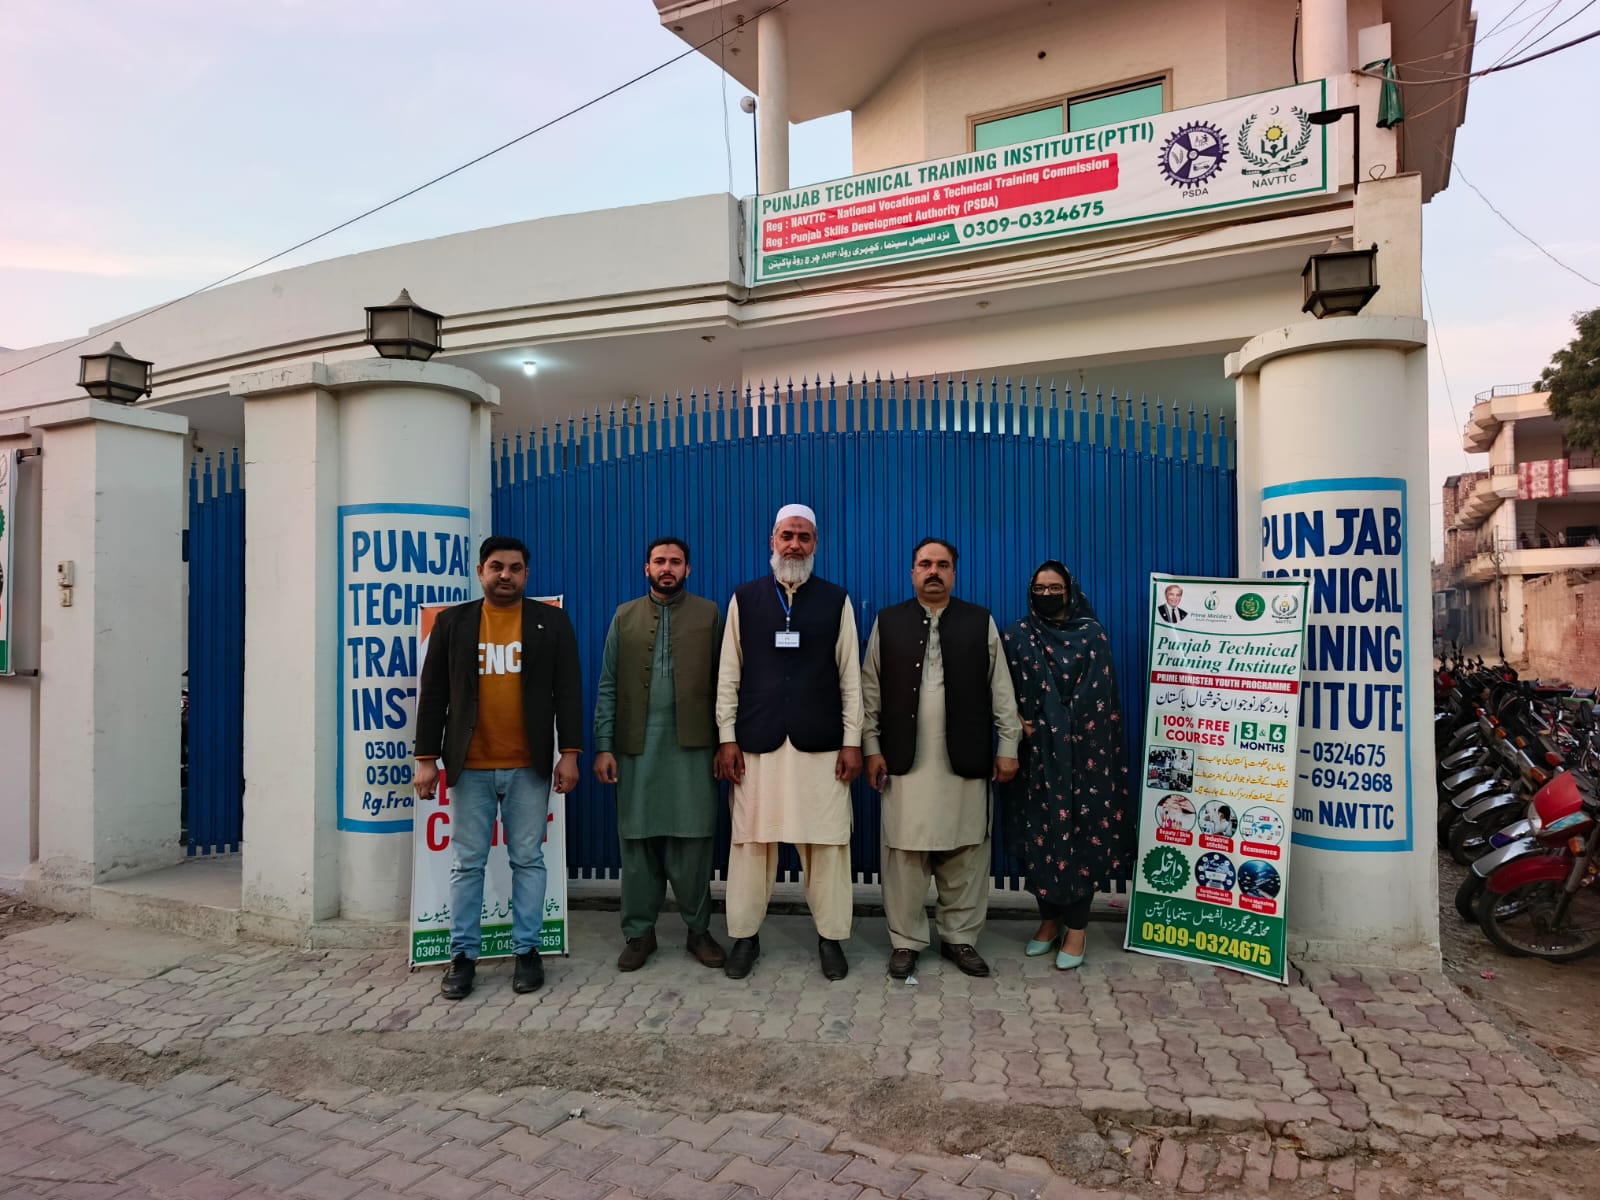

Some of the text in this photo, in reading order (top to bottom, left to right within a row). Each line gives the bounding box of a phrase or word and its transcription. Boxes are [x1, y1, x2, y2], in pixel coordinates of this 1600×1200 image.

[762, 188, 820, 214] PUNJAB
[826, 171, 912, 202] TECHNICAL
[918, 153, 997, 184] TRAINING
[1252, 174, 1297, 188] NAVTTC
[766, 220, 784, 234] Reg
[791, 211, 826, 228] NAVTTC
[837, 204, 876, 220] National
[879, 194, 930, 213] Vocational
[933, 190, 941, 200] &
[944, 180, 992, 200] Technical
[996, 172, 1040, 191] Training
[1042, 158, 1110, 180] Commission
[1182, 188, 1209, 198] PSDA
[766, 236, 783, 250] Reg
[791, 229, 822, 246] Punjab
[824, 224, 849, 238] Skills
[851, 212, 914, 234] Development
[916, 204, 961, 223] Authority
[964, 195, 999, 214] (PSDA)
[963, 200, 1105, 240] 0309-0324675
[884, 238, 908, 250] سینما
[822, 250, 837, 260] ARP
[1262, 508, 1402, 562] PUNJAB
[1156, 636, 1298, 658] Punjab Technical
[1156, 653, 1296, 676] Training Institute
[1157, 673, 1292, 692] PRIME MINISTER YOUTH PROGRAMME
[1156, 688, 1186, 712] پاکستان
[1163, 715, 1230, 732] 100% FREE
[1244, 724, 1254, 738] 3
[1272, 726, 1283, 738] 6
[1166, 729, 1225, 746] COURSES
[1240, 741, 1285, 753] MONTHS
[1292, 800, 1394, 830] om NAVTTC
[1172, 907, 1192, 921] سینما
[1142, 922, 1272, 966] 0309-0324675
